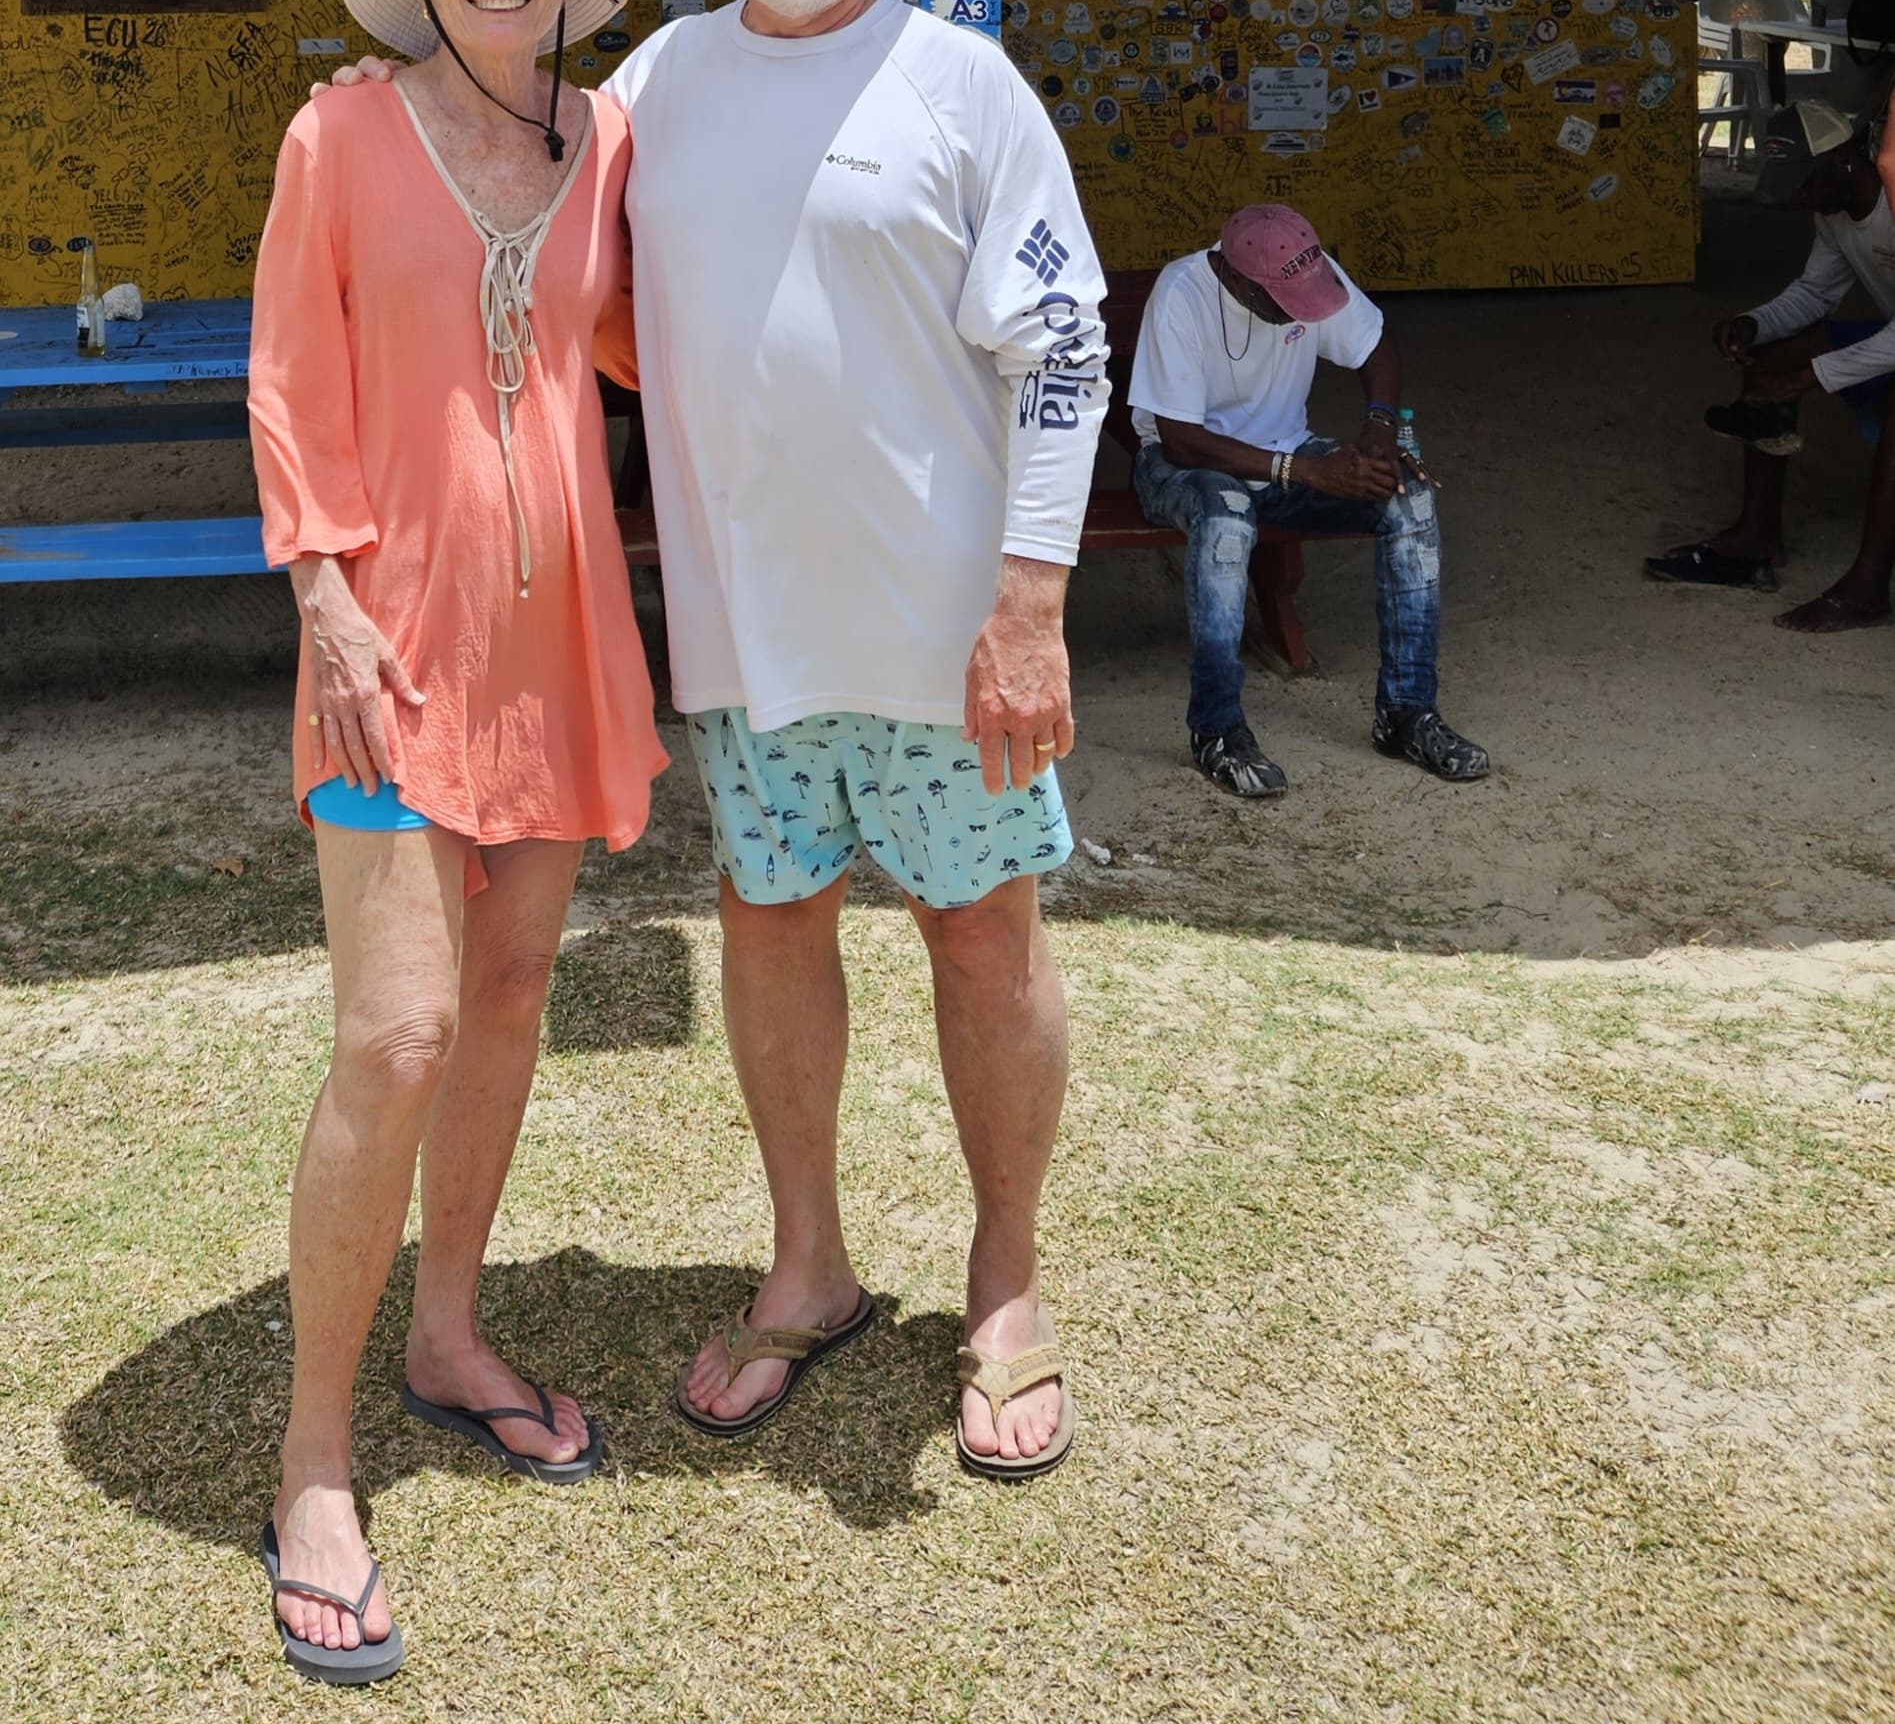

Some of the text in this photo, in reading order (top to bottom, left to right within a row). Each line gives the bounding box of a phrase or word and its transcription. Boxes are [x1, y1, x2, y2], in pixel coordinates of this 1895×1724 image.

[84, 14, 138, 49] ECU
[836, 154, 881, 171] Columbia
[1509, 265, 1547, 287] PAIN
[1551, 261, 1619, 285] KILLERS
